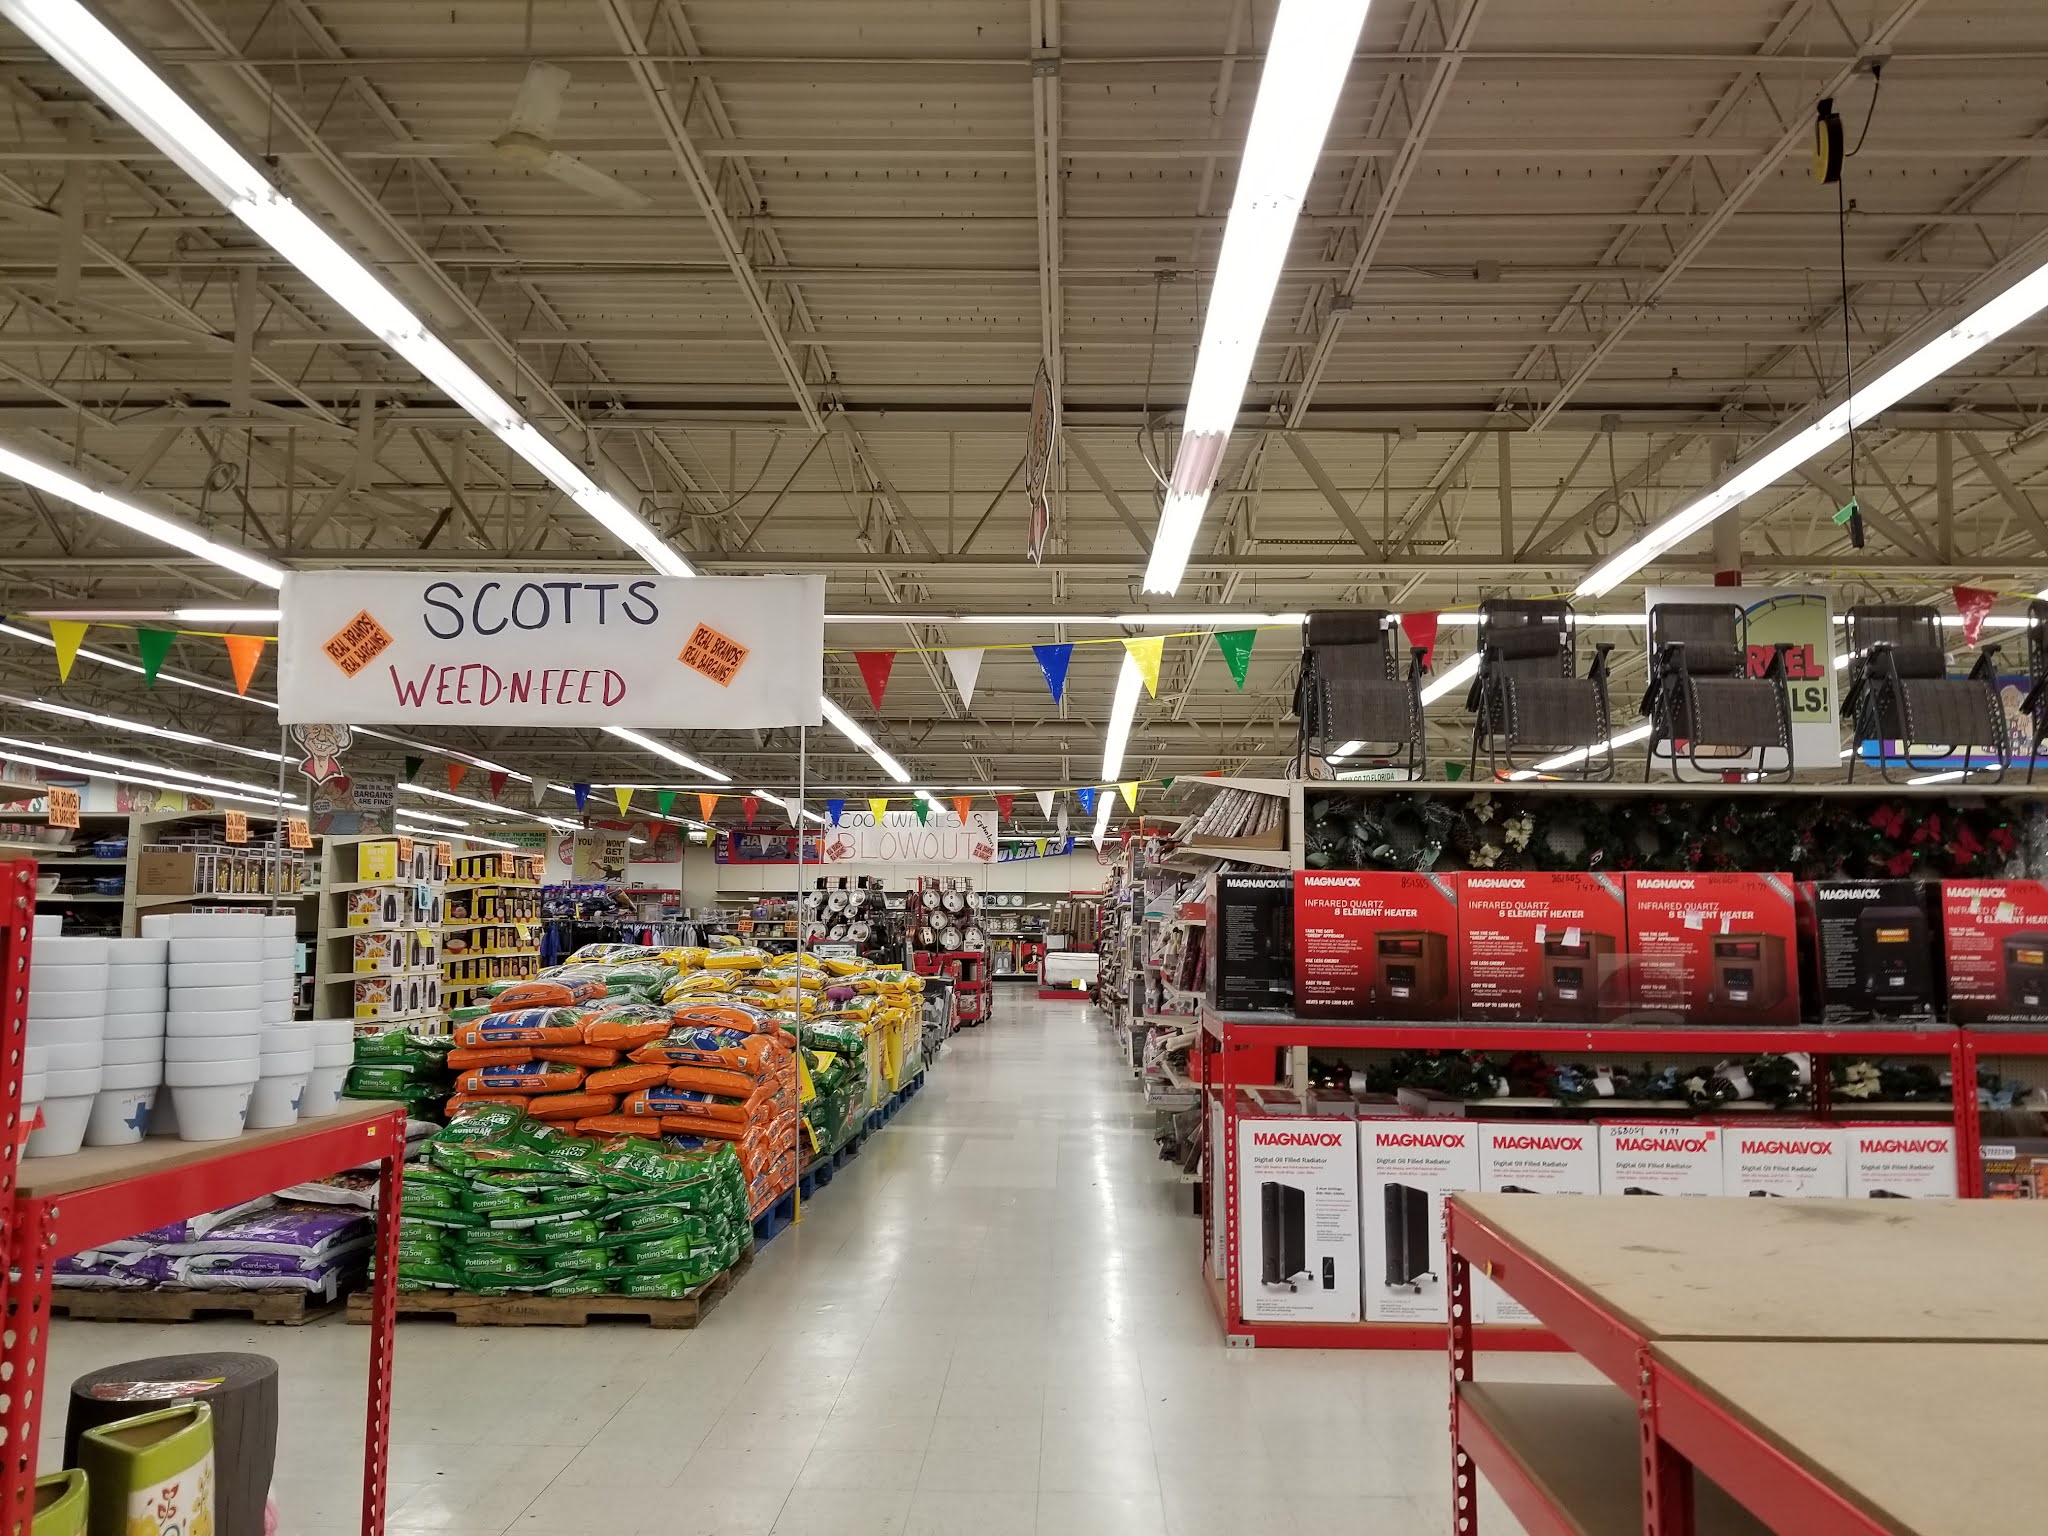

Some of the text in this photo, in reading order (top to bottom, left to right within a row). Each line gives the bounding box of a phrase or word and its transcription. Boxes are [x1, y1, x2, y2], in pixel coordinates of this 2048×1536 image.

[423, 581, 659, 640] SCOTTS
[327, 613, 376, 661] REAL BRANDS!
[340, 627, 388, 674] REAL BARGAINS!
[692, 628, 746, 667] REAL BRANDS!
[682, 646, 734, 683] REAL BARGAINS!
[354, 791, 394, 799] BARGAINS
[578, 838, 592, 846] YOU
[838, 832, 977, 861] BLOWOUT
[1227, 879, 1279, 888] MAGNAVOX
[1304, 877, 1360, 887] MAGNAVOX
[1468, 878, 1525, 888] MAGNAVOX
[1636, 880, 1695, 890] MAGNAVOX
[1820, 889, 1880, 900] MAGNAVOX
[1947, 888, 2006, 898] MAGNAVOX
[1305, 900, 1384, 909] INFRARED QUARTZ
[1469, 901, 1549, 910] INFRARED QUARTZ
[1638, 902, 1719, 911] INFRARED QUARTZ
[1335, 908, 1417, 917] 8 ELEMENT HEATER
[1499, 910, 1584, 918] 8 ELEMENT HEATER
[1677, 911, 1717, 919] ELENT
[1254, 1133, 1342, 1146] MAGNAVOX
[1376, 1134, 1465, 1148] MAGNAVOX
[1493, 1136, 1583, 1151] MAGNAVOX
[1616, 1138, 1707, 1152] MAGNAVOX
[1742, 1141, 1832, 1155] MAGNAVOX
[1860, 1140, 1948, 1153] MAGNAVOX
[554, 1191, 590, 1202] Potting Soil
[473, 1196, 510, 1208] Potting Soil
[632, 1212, 669, 1227] Potting Soil
[672, 1216, 679, 1224] 8
[546, 1229, 582, 1240] Potting Soil
[637, 1248, 673, 1261] Potting Soil
[678, 1252, 684, 1260] 8
[267, 1262, 280, 1270] Soil
[506, 1264, 512, 1272] 8
[555, 1260, 577, 1269] Potting
[596, 1263, 601, 1271] 8
[552, 1286, 575, 1294] Potting
